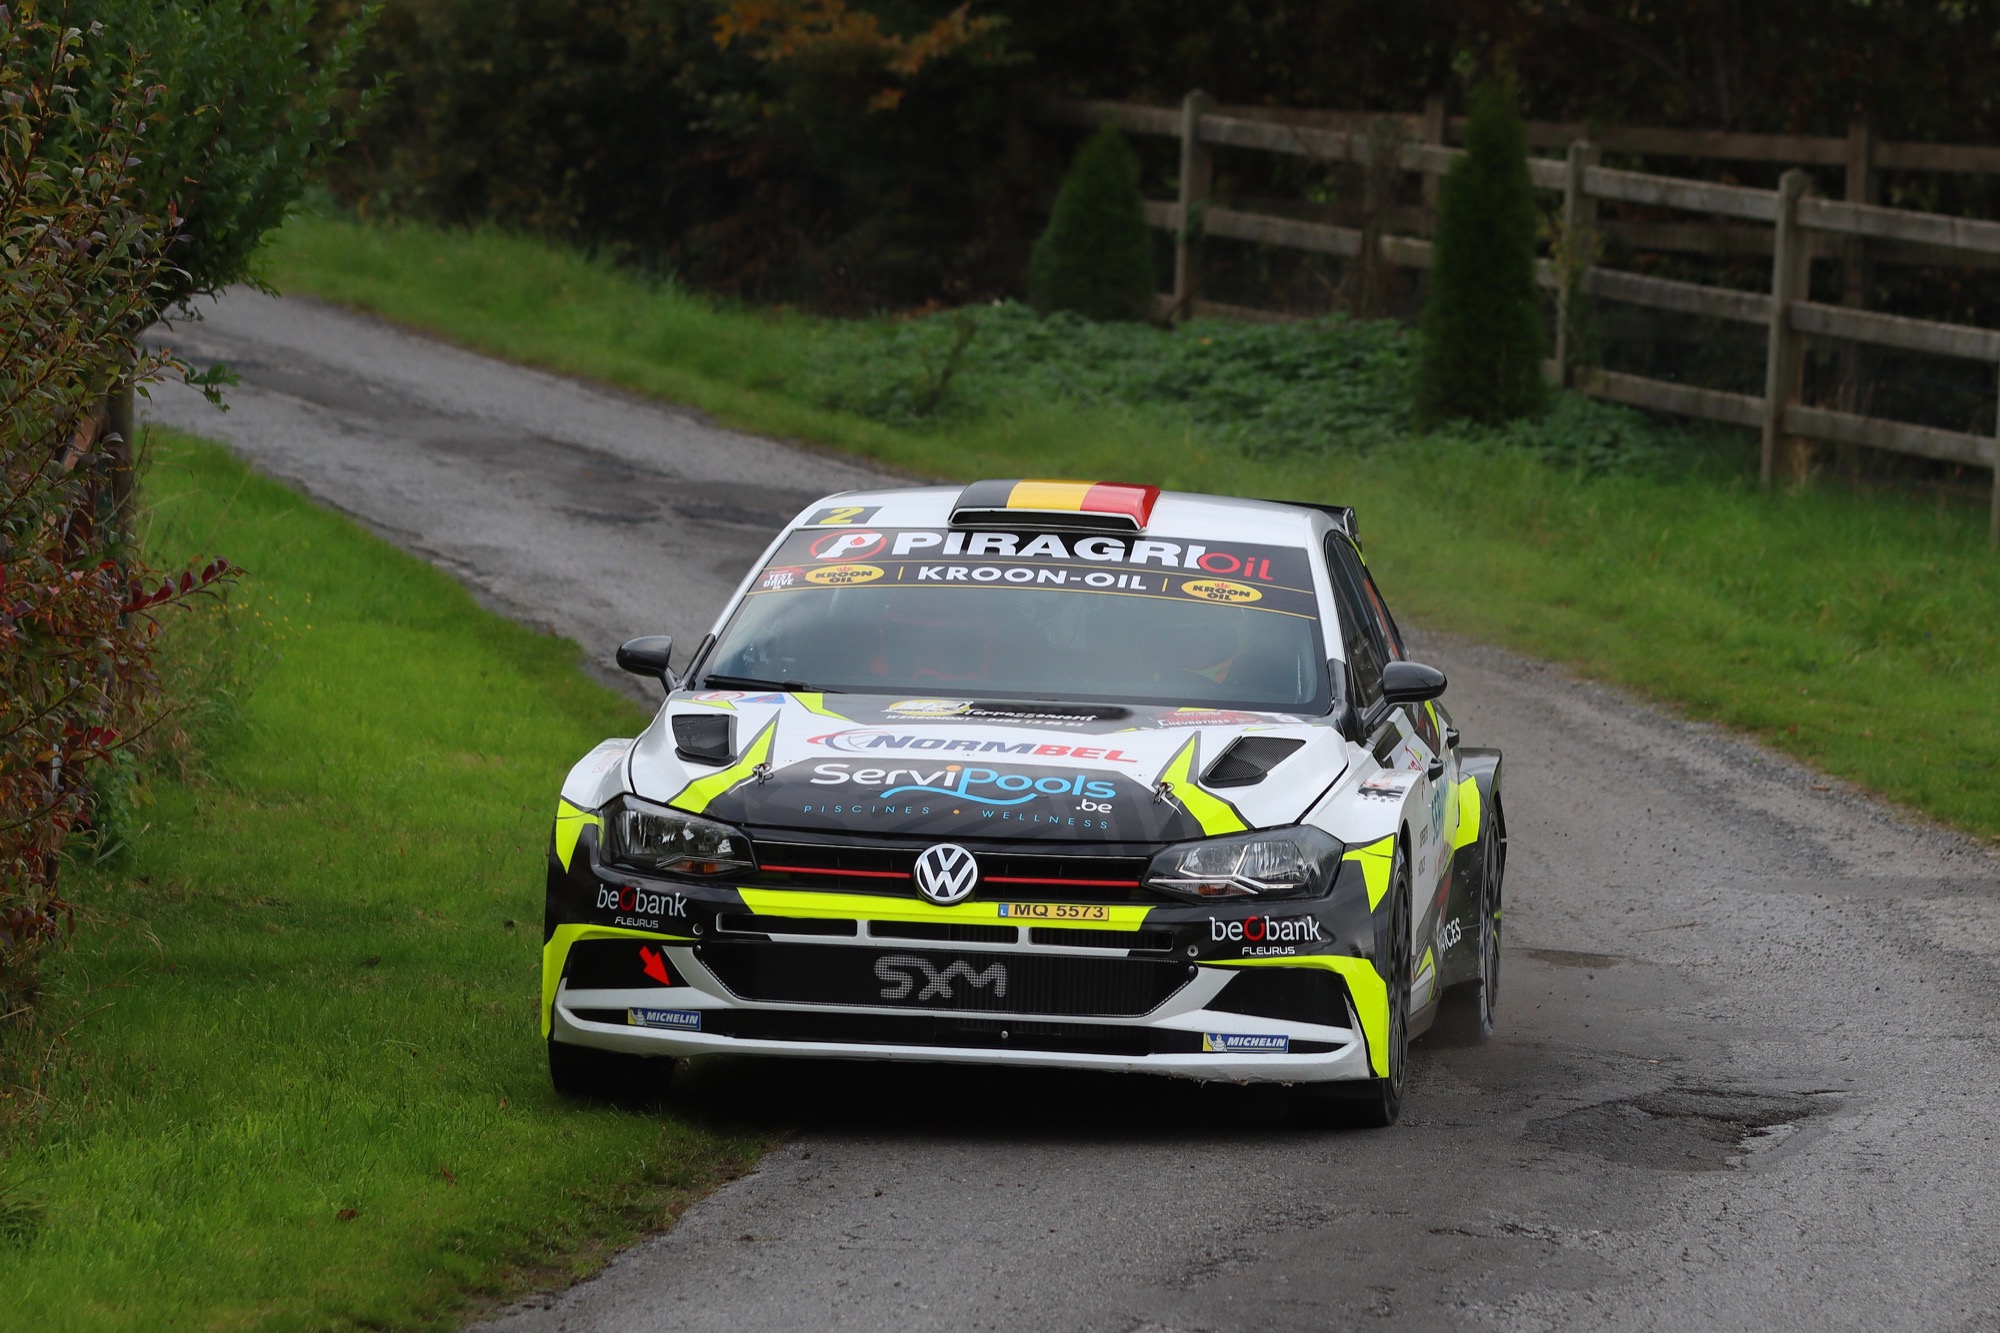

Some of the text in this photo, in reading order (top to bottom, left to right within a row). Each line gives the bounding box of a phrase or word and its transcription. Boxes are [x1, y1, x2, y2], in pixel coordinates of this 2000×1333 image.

[819, 507, 865, 525] 2
[815, 570, 873, 579] KROON
[917, 566, 1147, 590] KROON-OIL
[1192, 584, 1251, 598] KROON
[1206, 592, 1232, 601] OIL
[866, 735, 1139, 764] NORMBEL
[809, 763, 1117, 805] ServiPools
[803, 805, 1108, 829] PISCINES WELLNESS
[1014, 904, 1049, 917] MQ
[1055, 905, 1105, 918] 5573
[614, 916, 659, 929] FLEURUS
[1241, 946, 1296, 955] FLEURUS
[646, 1011, 699, 1025] MICHELIN
[1226, 1036, 1287, 1048] MICHELIN
